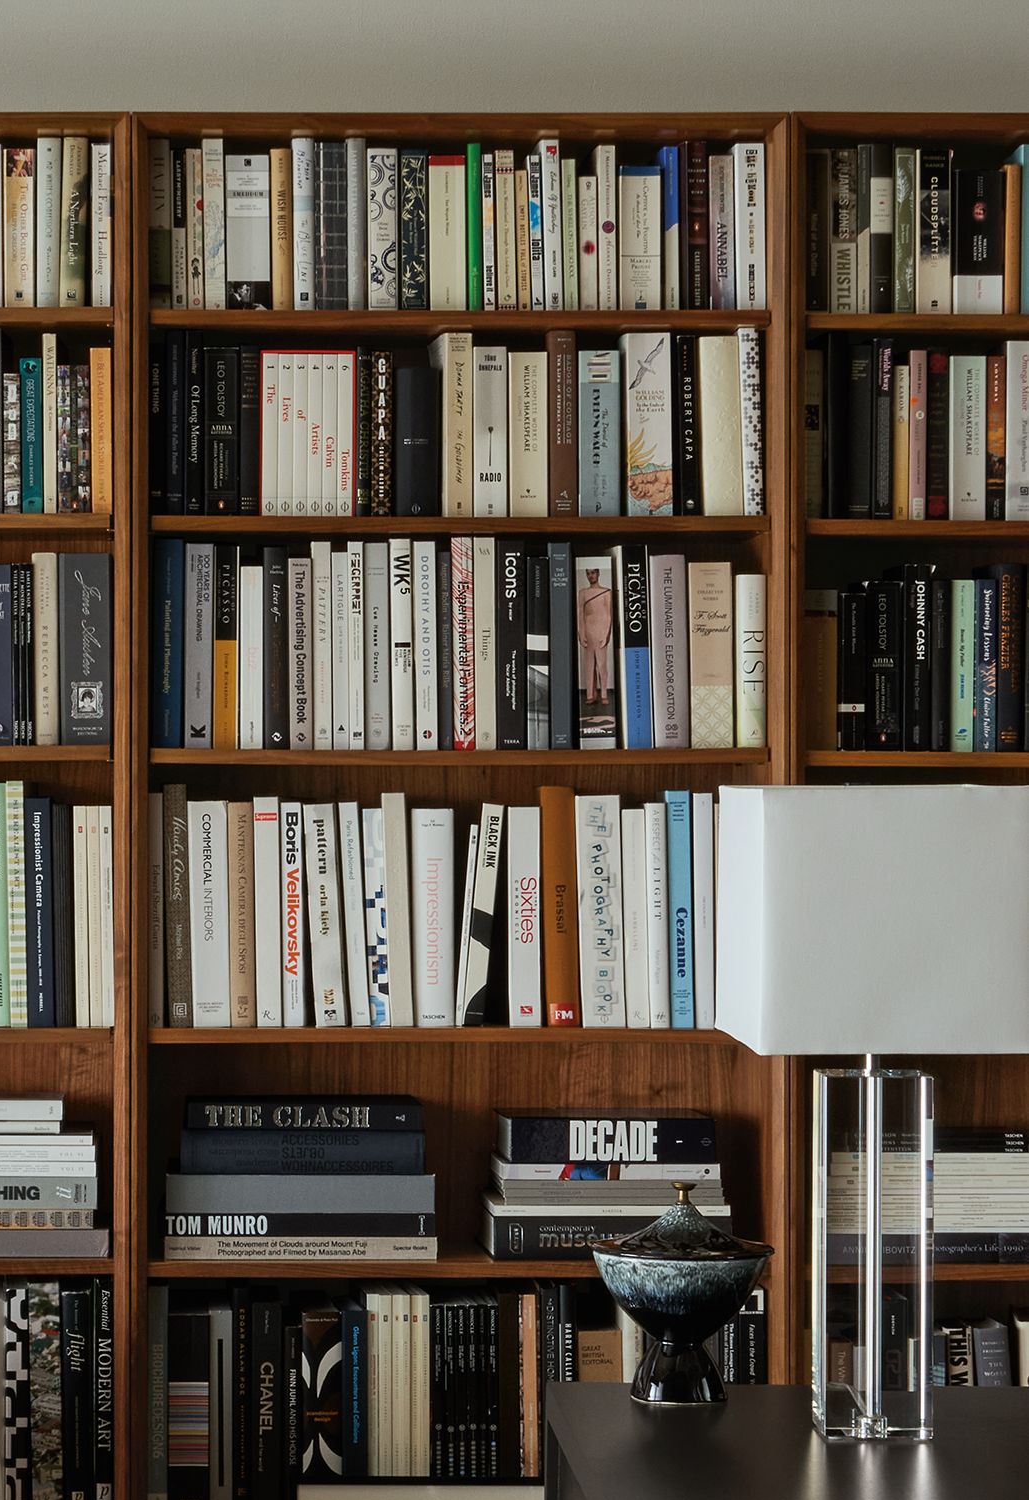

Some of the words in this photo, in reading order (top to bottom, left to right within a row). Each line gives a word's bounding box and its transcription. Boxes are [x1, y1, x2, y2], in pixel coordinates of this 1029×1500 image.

[98, 152, 107, 191] Michael
[531, 161, 539, 173] Bill
[531, 174, 540, 198] James
[71, 190, 79, 198] A
[94, 195, 107, 222] Frayn
[839, 173, 849, 205] JAMES
[69, 201, 79, 240] Northern
[839, 209, 850, 239] JONES
[68, 242, 78, 265] Light
[95, 231, 107, 275] Headlong
[717, 222, 727, 281] ANNABEL
[836, 248, 851, 310] WHISTLE
[191, 385, 199, 398] Of
[267, 384, 275, 404] The
[282, 397, 291, 421] Lives
[684, 377, 692, 423] ROBERT
[190, 400, 199, 423] Long
[297, 410, 306, 420] of
[189, 425, 199, 463] Memory
[311, 423, 320, 455] Artists
[326, 437, 334, 467] Calvin
[685, 430, 693, 461] CAPA
[341, 449, 349, 491] Tomkins
[74, 570, 101, 615] Jane
[295, 571, 305, 590] The
[421, 556, 429, 612] DOROTHY
[506, 552, 520, 598] icons
[663, 568, 672, 584] THE
[628, 564, 642, 632] PICASSO
[664, 587, 673, 638] LUMINARIES
[915, 581, 925, 626] JOHNNY
[294, 592, 305, 650] Advertising
[81, 620, 101, 676] Austen
[422, 649, 430, 675] OTIS
[665, 645, 674, 683] ELEANOR
[743, 630, 764, 695] RISE
[916, 629, 925, 660] CASH
[295, 654, 306, 695] Concept
[297, 698, 307, 724] Book
[666, 686, 675, 719] CATTON
[202, 814, 212, 884] COMMERCIAL
[286, 812, 298, 864] Boris
[487, 816, 499, 847] BLACK
[486, 851, 497, 868] INK
[204, 888, 213, 941] INTERIORS
[285, 868, 300, 976] Velikovsky
[422, 857, 443, 985] Impressionism
[520, 877, 537, 943] Sixties
[555, 885, 567, 934] Brassaï
[676, 907, 688, 977] Cezanne
[205, 1106, 262, 1128] THE
[273, 1106, 370, 1128] CLASH
[569, 1120, 657, 1161] DECADE
[166, 1215, 201, 1235] TOM
[208, 1215, 268, 1235] MUNRO
[101, 1290, 110, 1330] Essential
[98, 1338, 111, 1412] MODERN
[259, 1362, 274, 1435] CHANEL
[98, 1418, 111, 1451] ART
